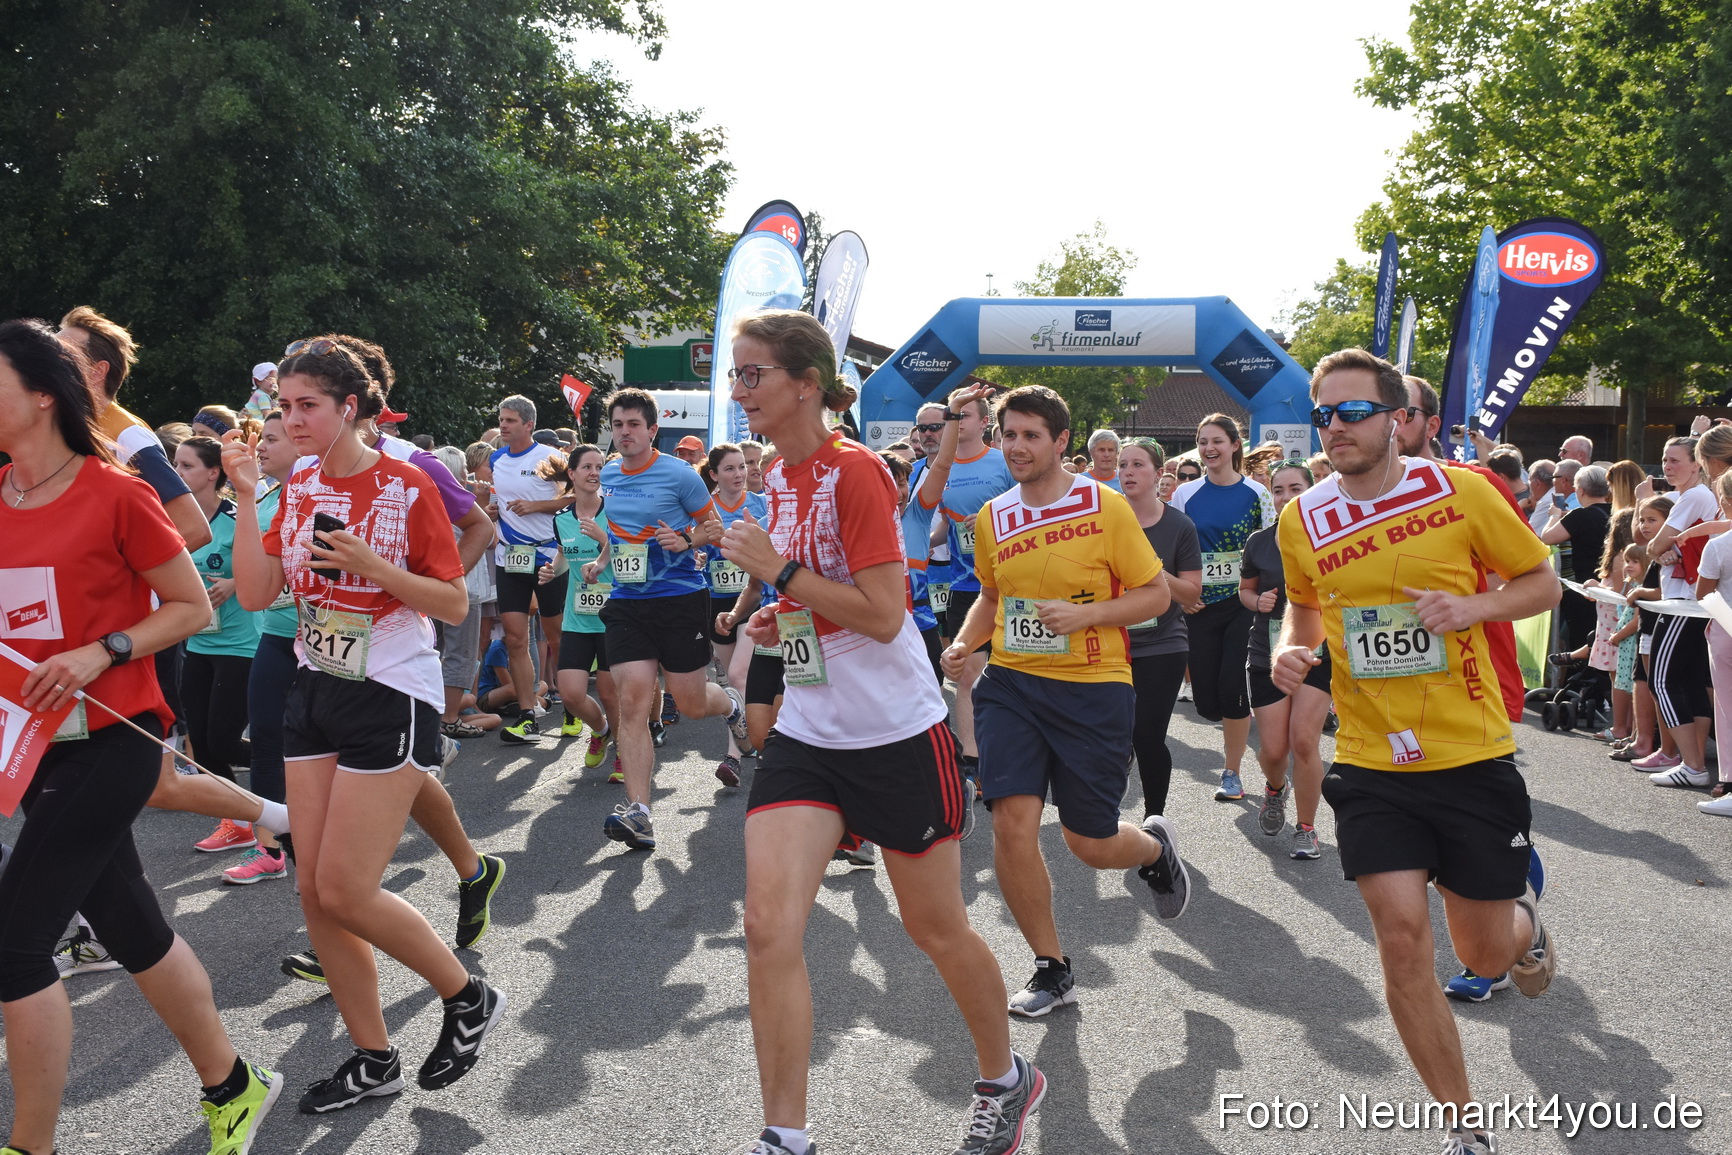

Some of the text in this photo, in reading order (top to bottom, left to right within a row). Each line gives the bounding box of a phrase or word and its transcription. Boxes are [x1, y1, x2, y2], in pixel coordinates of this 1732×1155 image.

[1505, 244, 1589, 275] Hervis
[1082, 316, 1109, 324] Fischer
[1062, 331, 1142, 346] firmenlauf
[909, 358, 952, 367] Fischer
[997, 520, 1103, 565] MAX BÖGL
[1316, 505, 1465, 577] MAX BÖGL
[507, 554, 530, 566] 1109
[613, 557, 640, 572] 1913
[1206, 563, 1232, 577] 213
[715, 571, 746, 584] 1917
[580, 593, 604, 606] 969
[20, 608, 39, 622] DEHN
[1357, 618, 1393, 629] firmenlauf
[304, 623, 357, 660] 2217
[1357, 627, 1431, 658] 1650
[321, 654, 347, 667] Veronika
[1393, 655, 1426, 665] Dominik
[7, 718, 44, 779] DEHN protects.
[397, 732, 406, 757] Reebok
